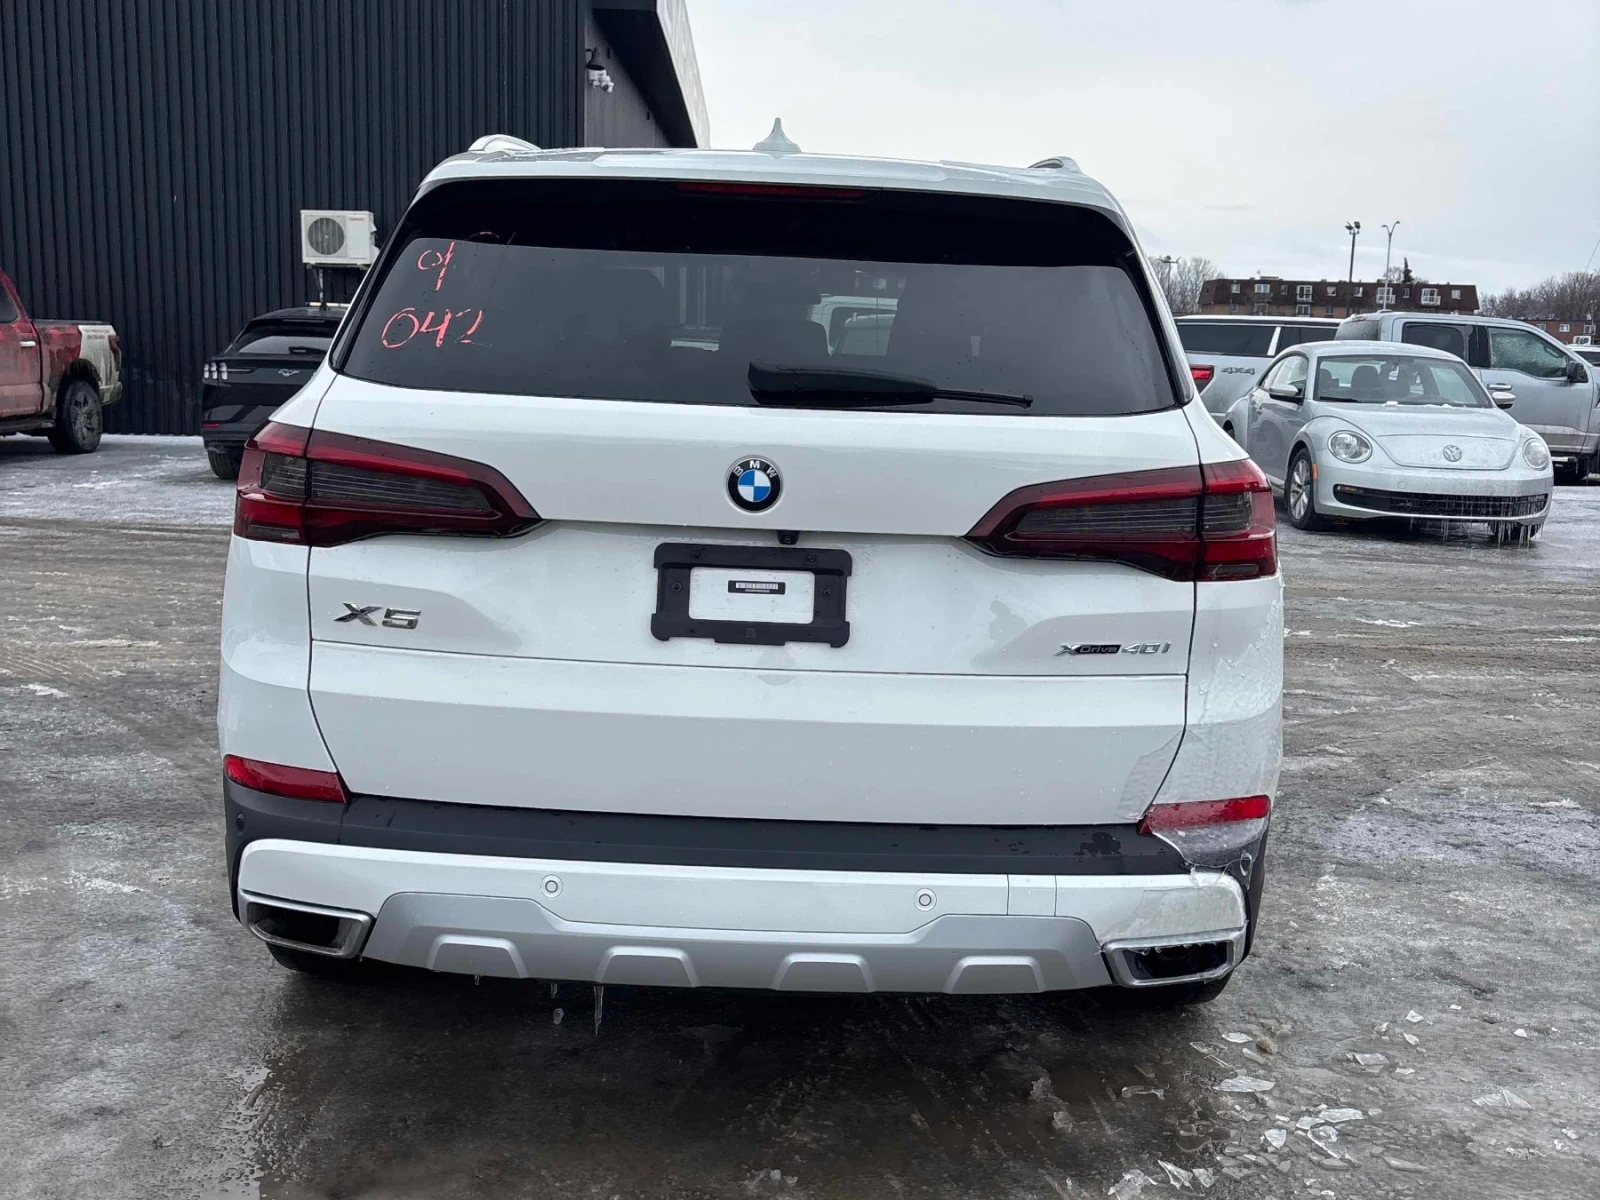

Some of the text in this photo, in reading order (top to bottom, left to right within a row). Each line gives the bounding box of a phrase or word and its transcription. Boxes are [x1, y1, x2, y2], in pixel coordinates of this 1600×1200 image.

[381, 307, 492, 349] 042
[733, 460, 778, 479] BMW
[332, 602, 422, 630] X5
